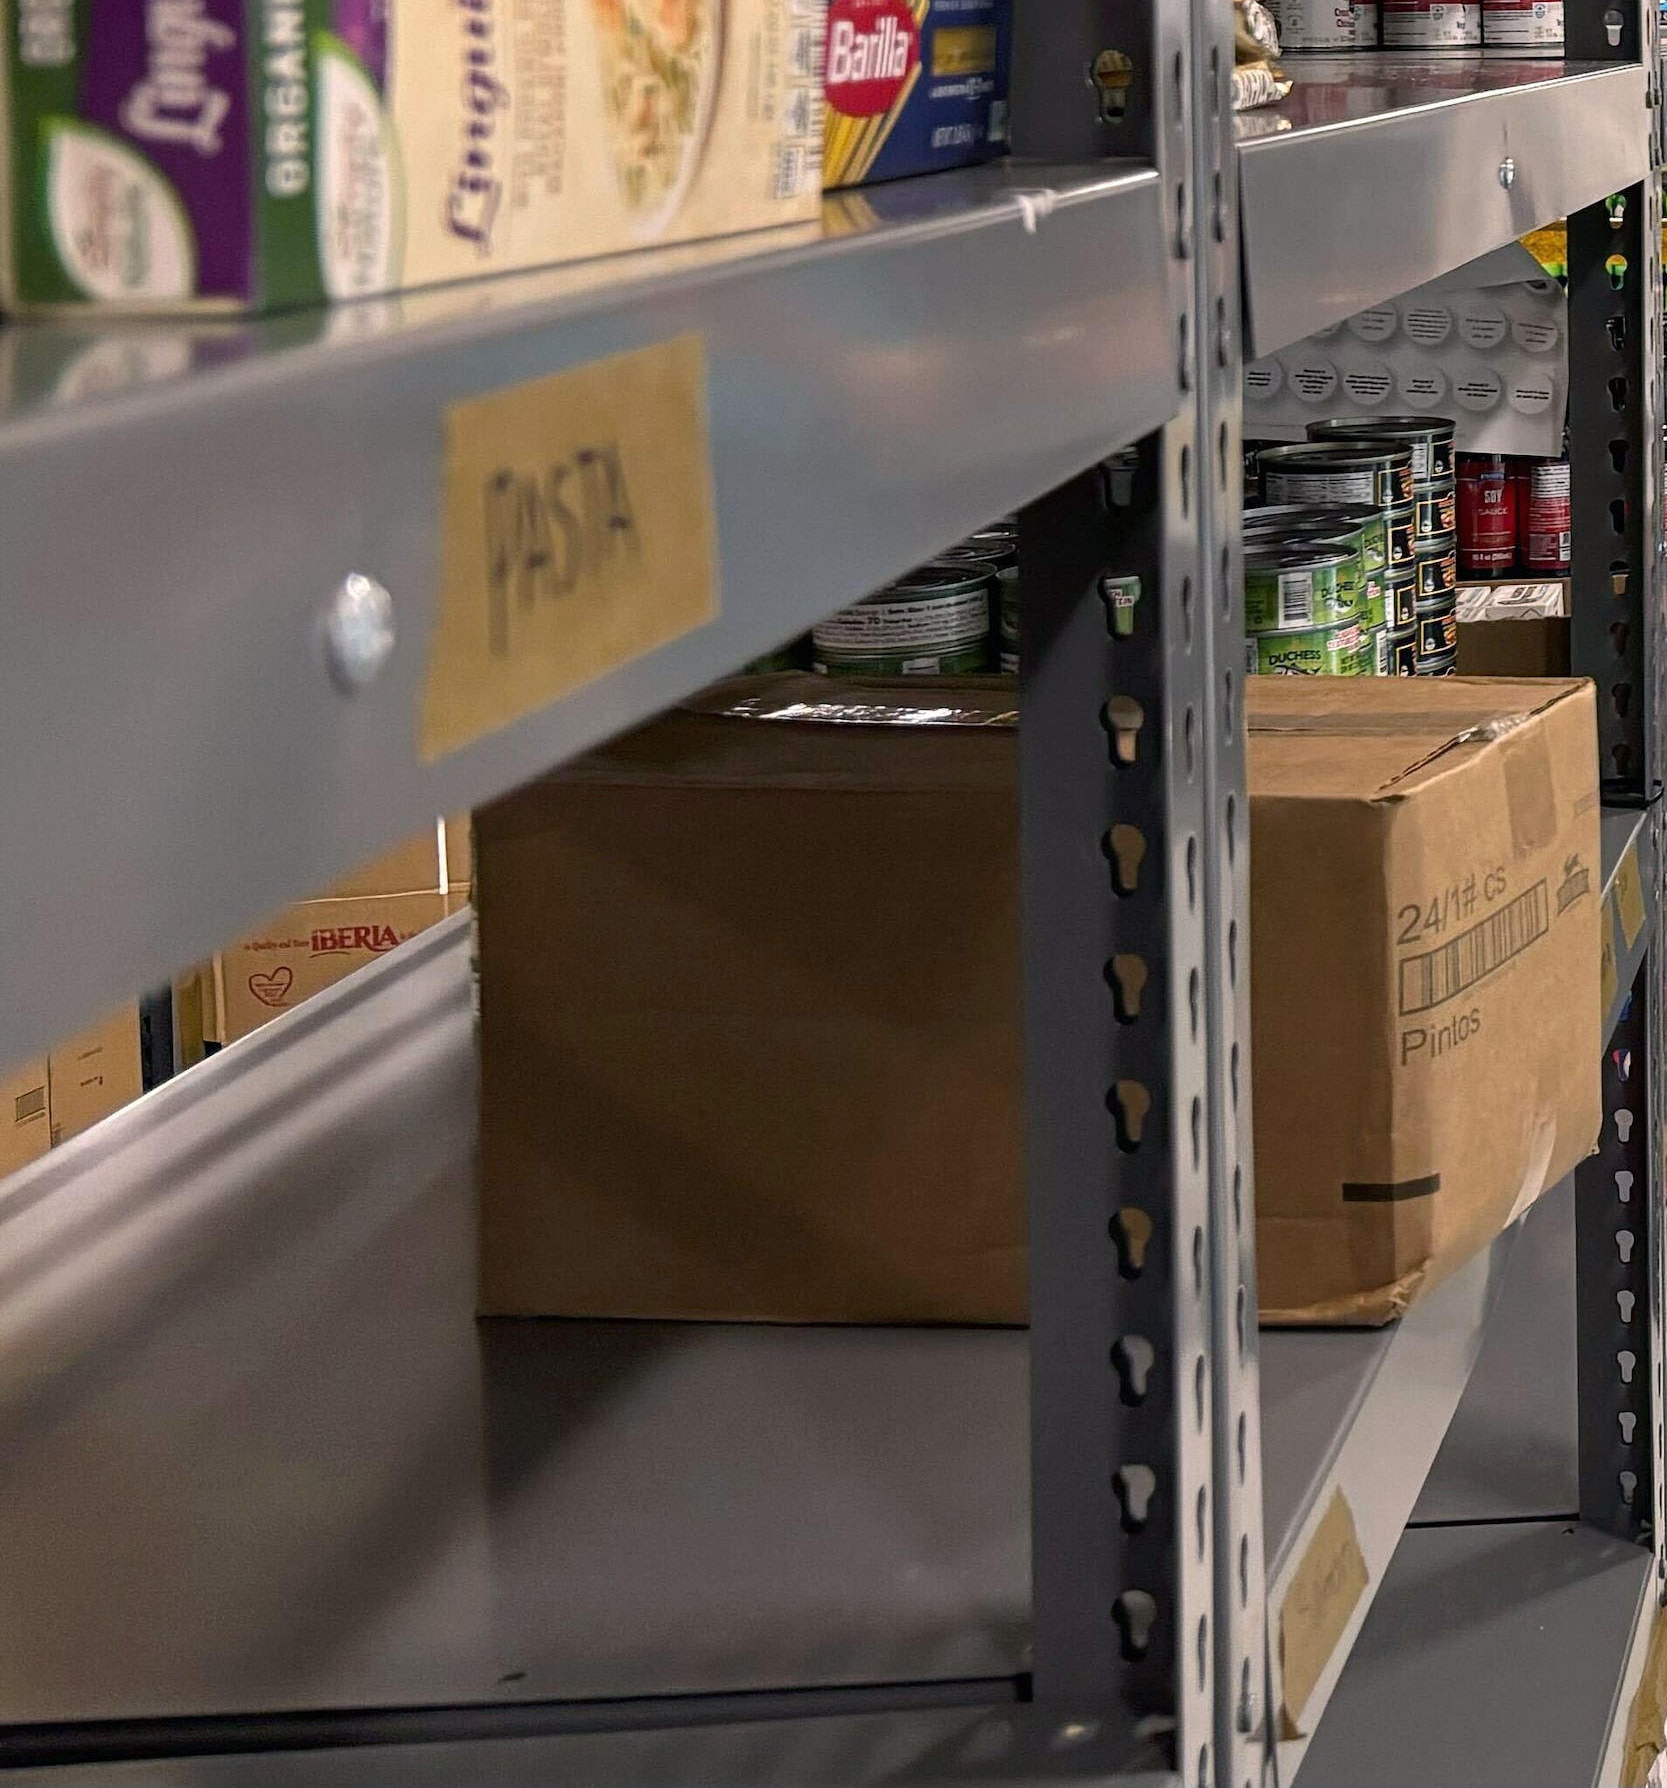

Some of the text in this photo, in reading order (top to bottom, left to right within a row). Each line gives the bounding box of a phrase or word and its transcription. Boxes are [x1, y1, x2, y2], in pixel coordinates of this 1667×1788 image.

[827, 15, 912, 85] Barilla
[1484, 489, 1503, 504] SOY
[482, 438, 645, 660] PASTA
[1269, 650, 1322, 666] DUCHESS
[311, 925, 399, 952] IBERIA
[1402, 1007, 1481, 1067] Pintos
